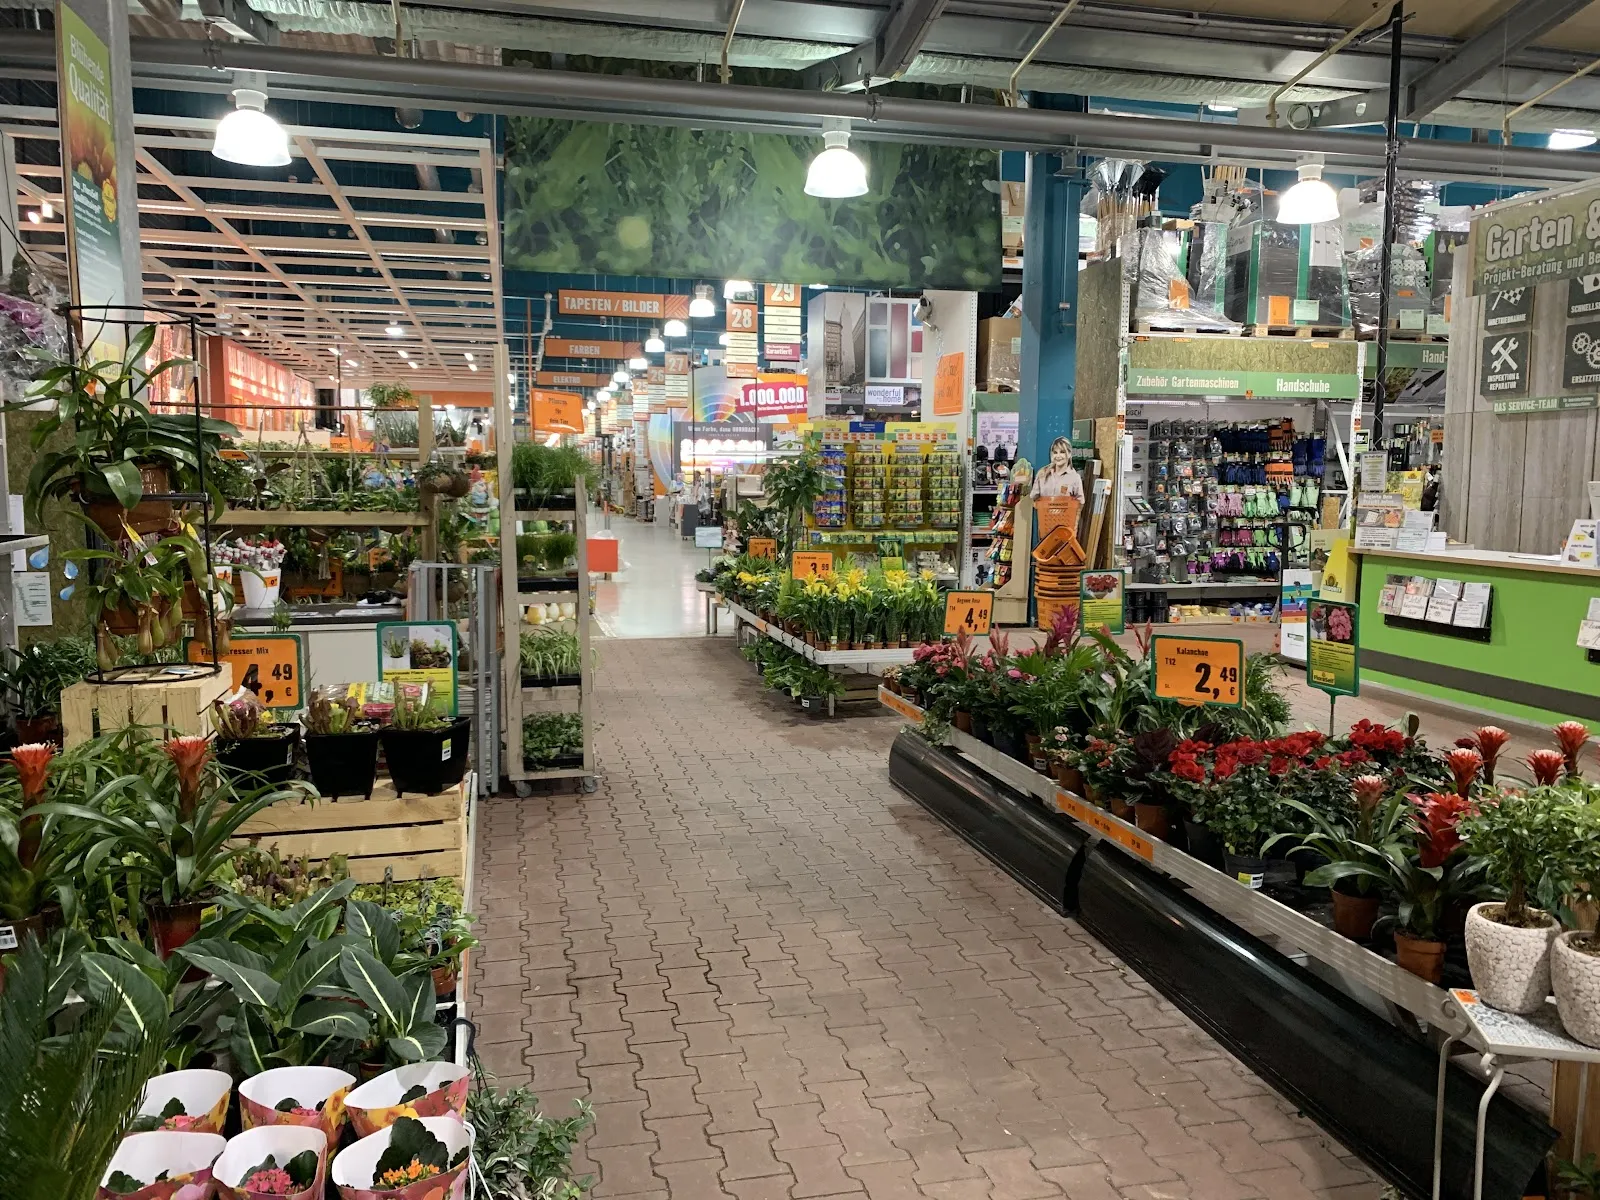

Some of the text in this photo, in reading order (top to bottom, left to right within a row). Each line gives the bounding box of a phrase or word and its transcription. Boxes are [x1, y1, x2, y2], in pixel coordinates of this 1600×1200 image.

[70, 34, 105, 85] Blühende
[69, 63, 110, 125] Qualität
[1486, 214, 1575, 262] Garten
[1483, 260, 1563, 285] Projekt-Beratung
[1566, 253, 1584, 269] und
[771, 283, 794, 302] 29
[564, 296, 660, 314] TAPETEN / BILDER
[731, 308, 752, 328] 28
[569, 344, 600, 355] FARBEN
[668, 357, 685, 372] 27
[553, 375, 581, 384] ELEKTRO
[650, 369, 665, 382] 26
[1136, 375, 1239, 389] Zubehör Gartenmaschinen
[867, 388, 901, 397] wonderful
[1276, 378, 1330, 393] Handschuhe
[741, 386, 804, 406] 1.000.000
[1493, 402, 1507, 412] DAS
[1508, 398, 1558, 411] SERVICE-TEAM
[978, 609, 988, 619] 49
[1176, 647, 1209, 657] Kalanchoe
[1165, 657, 1176, 666] T12
[271, 663, 293, 680] 49
[1220, 667, 1237, 683] 49
[285, 686, 293, 697] €
[1229, 686, 1236, 696] €
